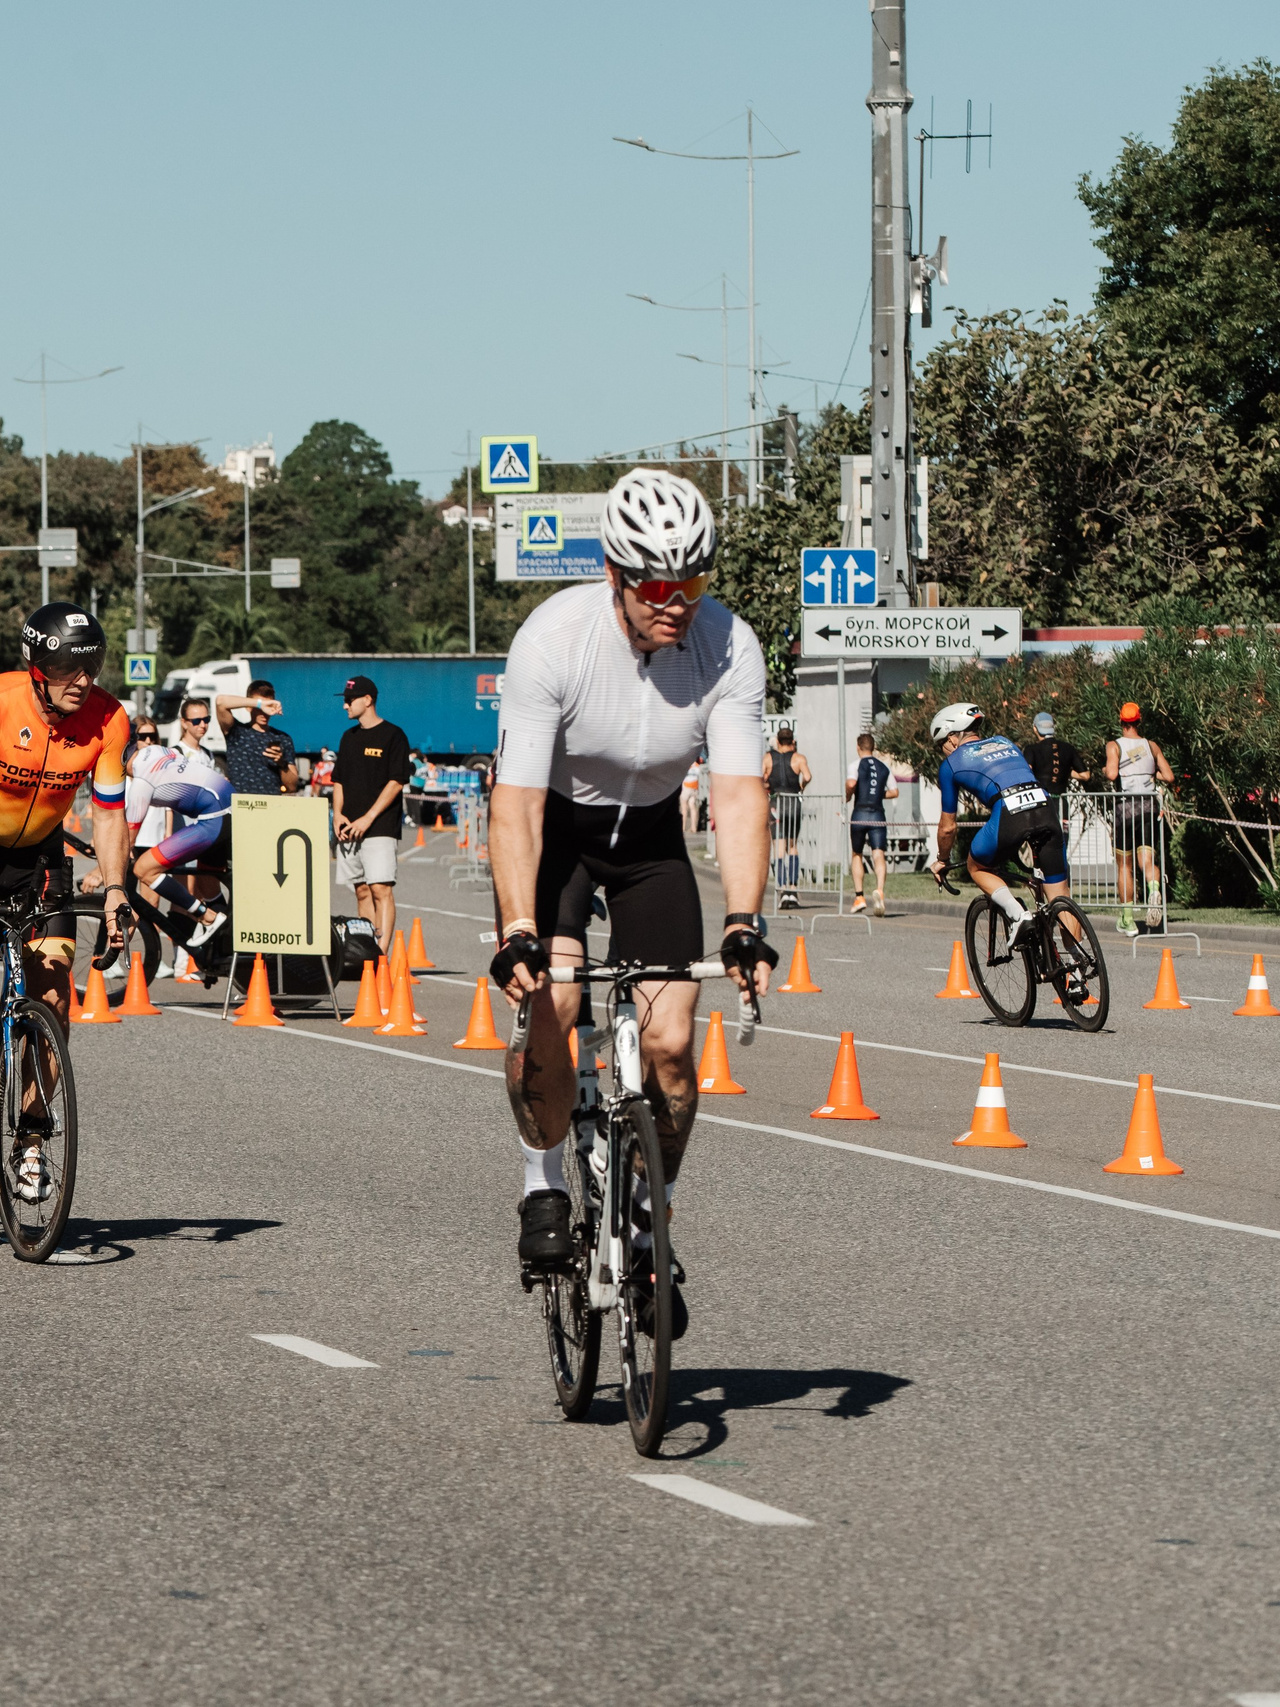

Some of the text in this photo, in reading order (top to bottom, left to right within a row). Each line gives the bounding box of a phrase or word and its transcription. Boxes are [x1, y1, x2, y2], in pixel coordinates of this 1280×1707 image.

[516, 496, 557, 504] МОРСКОЙ
[666, 537, 683, 546] 1527
[517, 557, 597, 566] КРАСНАЯ ПОЛЯНА
[517, 566, 565, 575] KRASNAYA
[846, 614, 970, 632] бул. МОРСКОЙ
[22, 623, 47, 642] UDY
[844, 635, 976, 648] MORSKOY Blvd.
[71, 645, 98, 653] RUDY
[983, 749, 1019, 762] UMKA
[1, 774, 81, 791] ТРИАТЛОН
[1016, 792, 1036, 805] 711
[240, 931, 302, 945] РАЗВОРОТ
